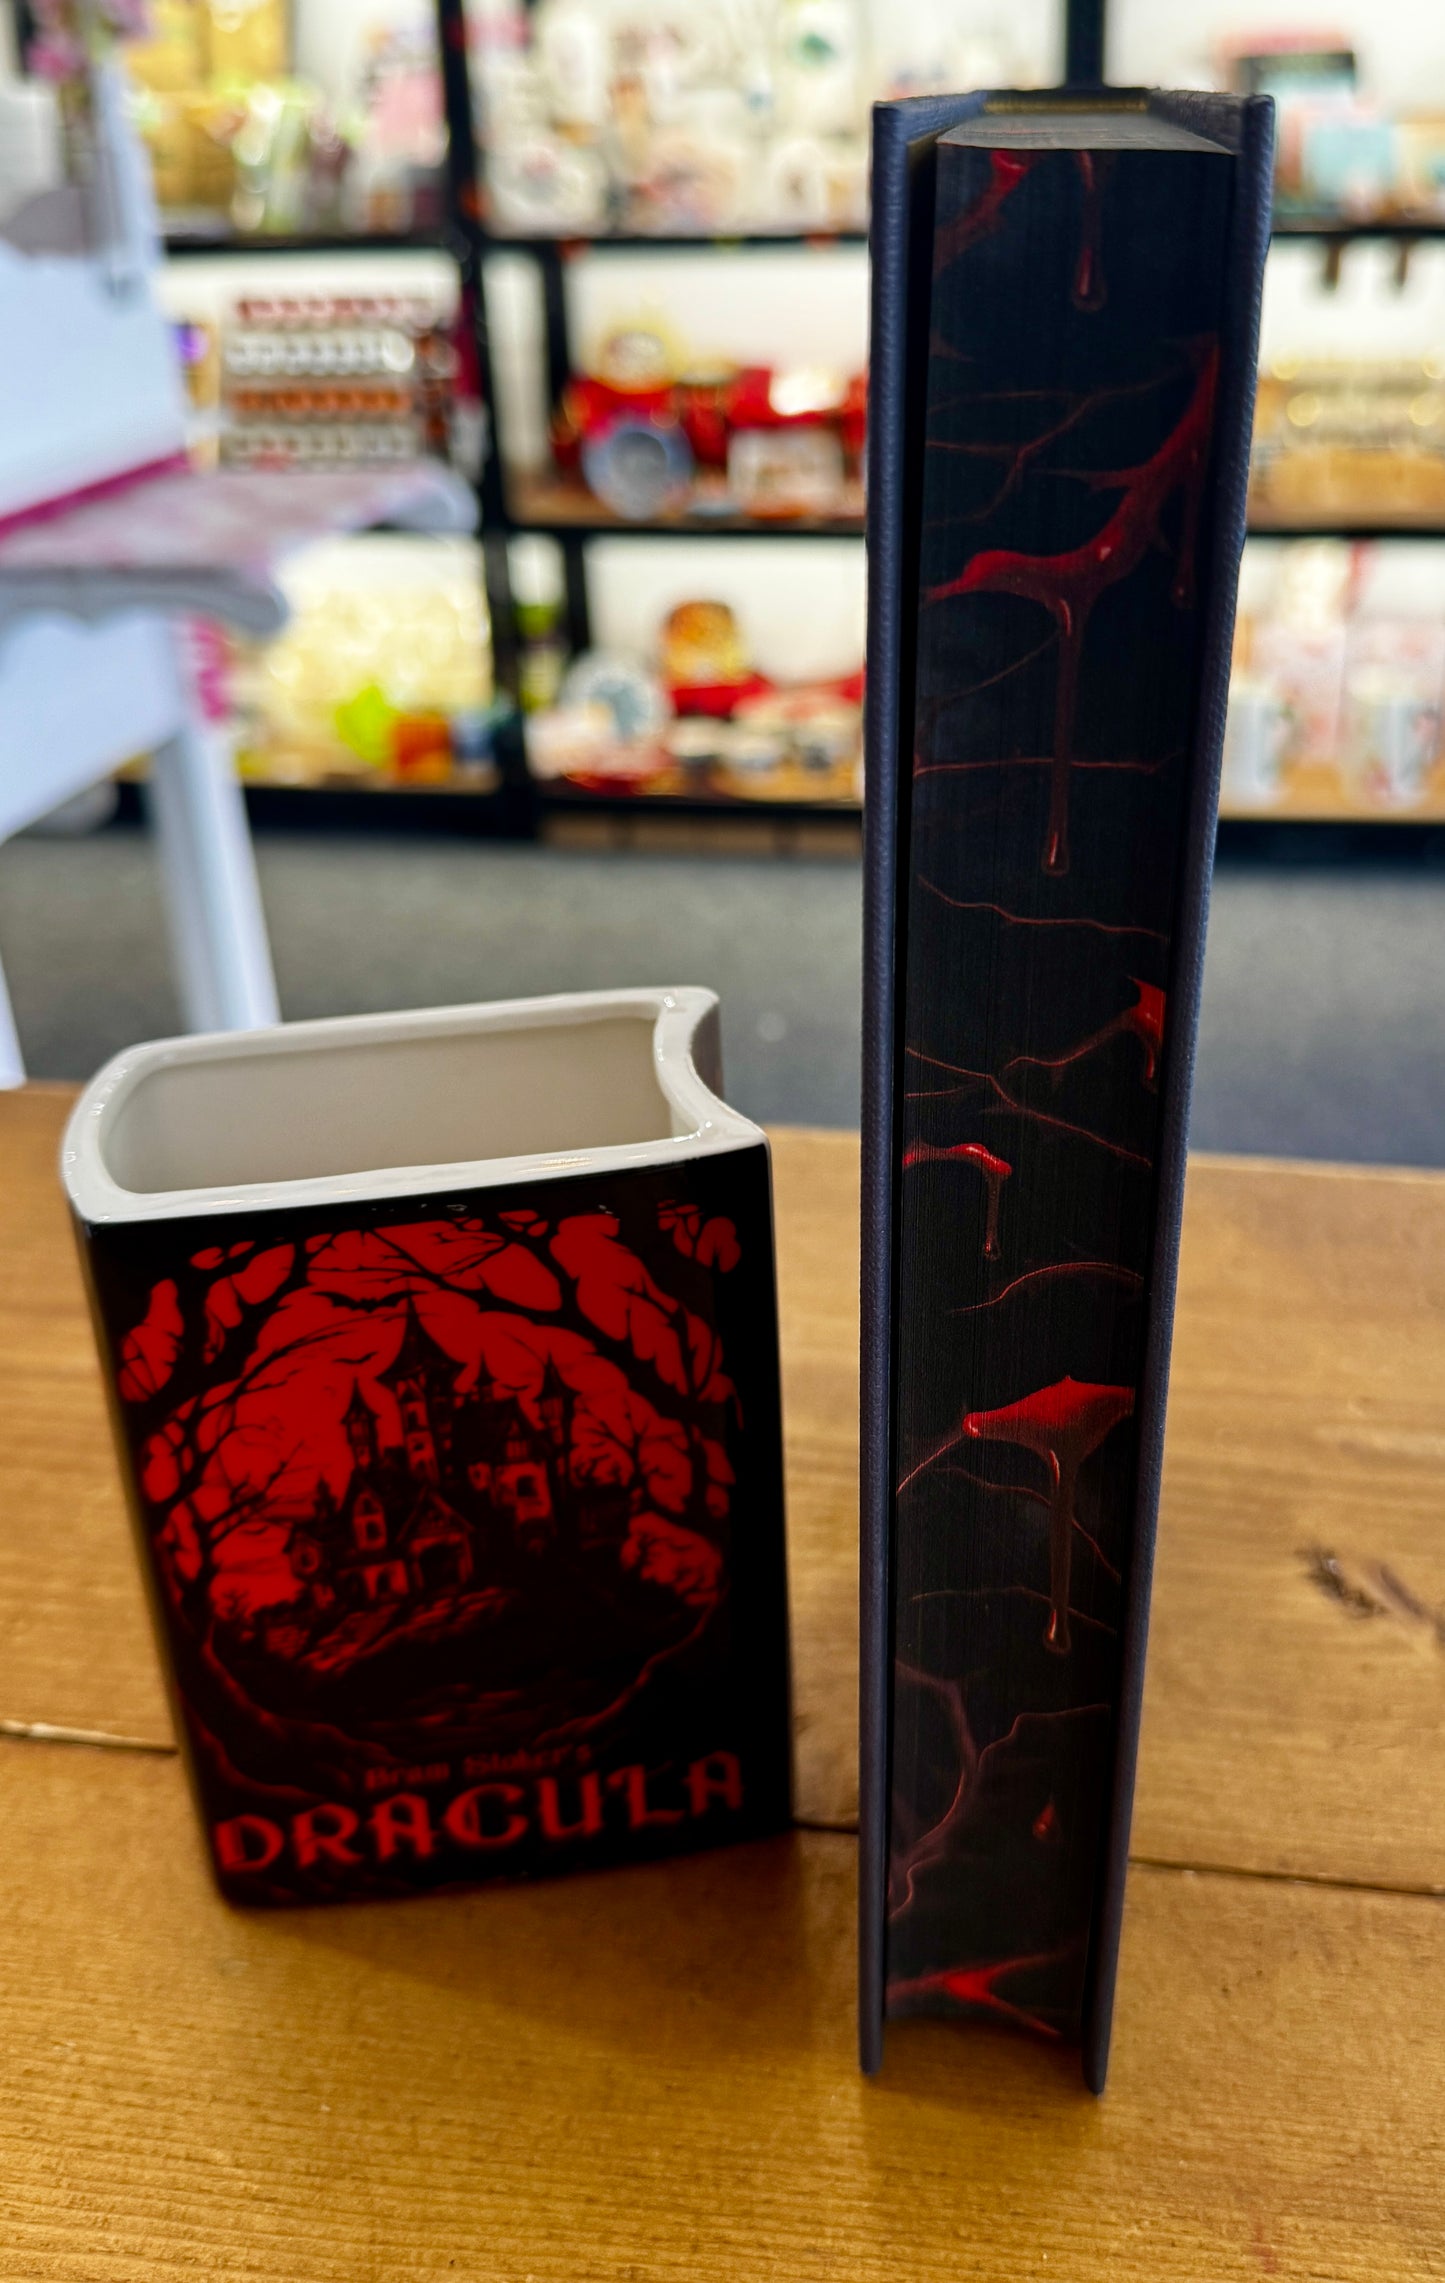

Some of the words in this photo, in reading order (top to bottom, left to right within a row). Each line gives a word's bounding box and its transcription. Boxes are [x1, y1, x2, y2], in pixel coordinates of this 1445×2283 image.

[365, 1763, 450, 1791] Bram
[463, 1744, 592, 1778] Stoker's
[215, 1749, 745, 1874] DRACULA
